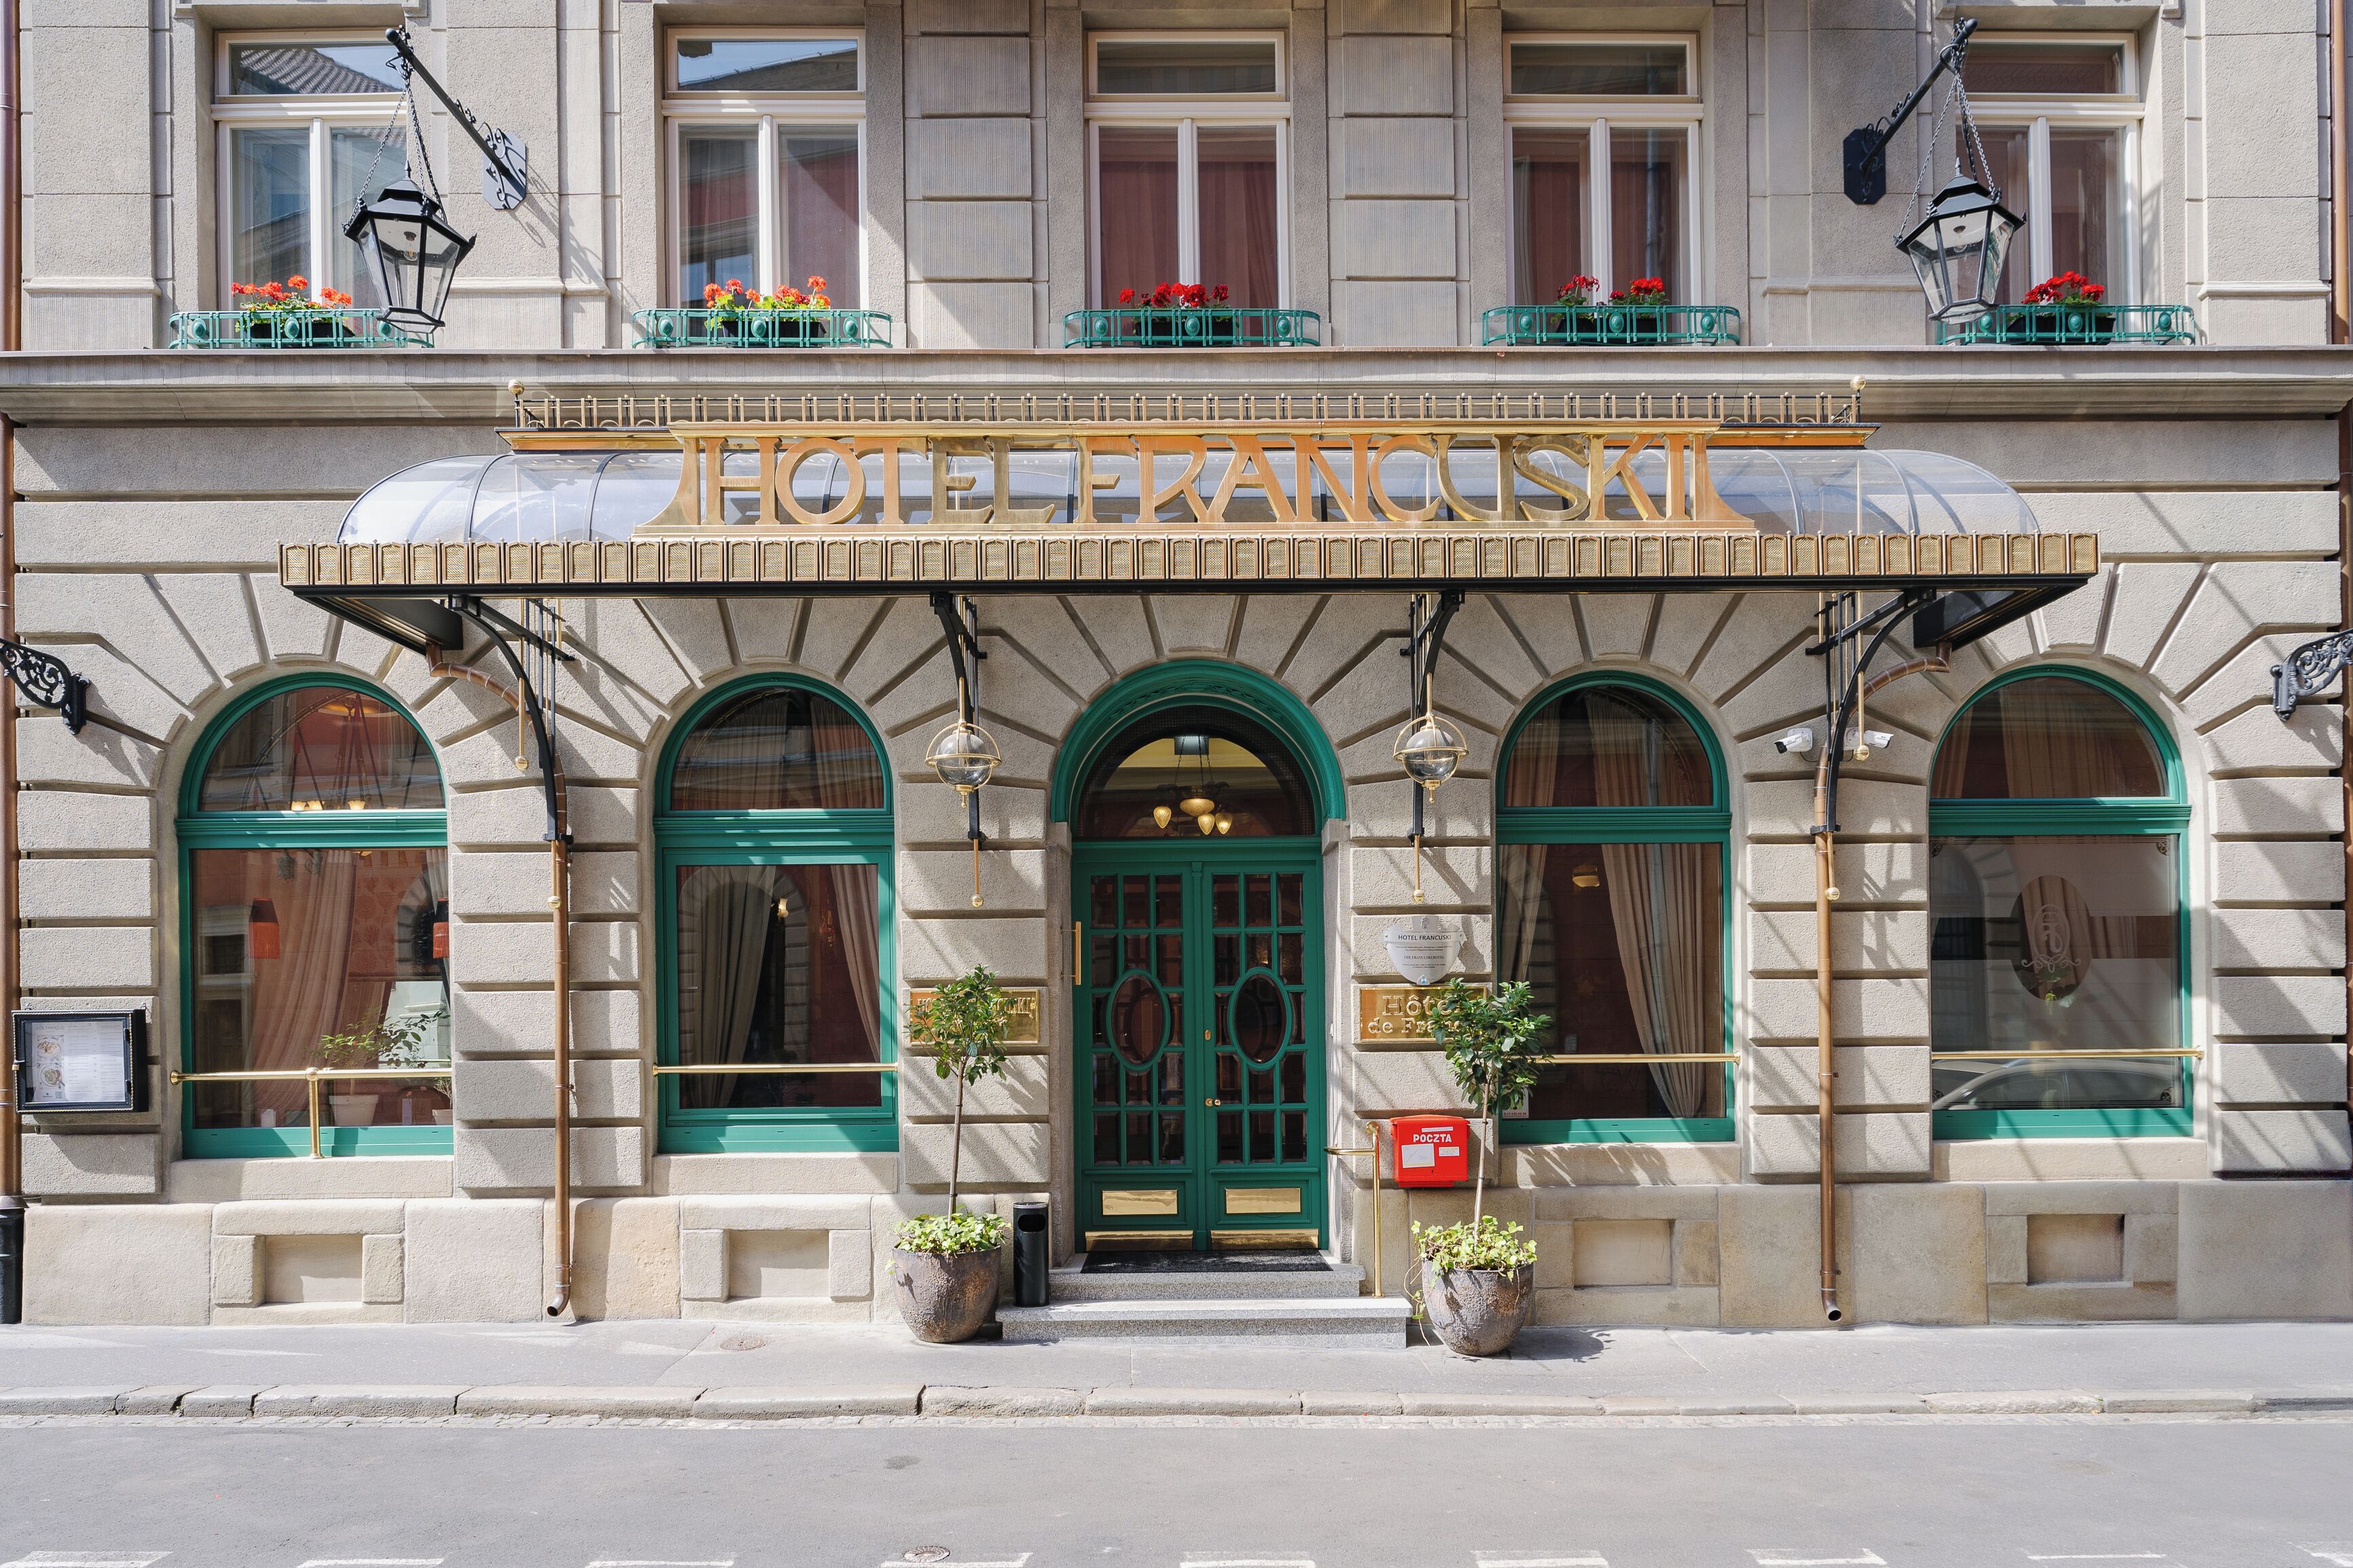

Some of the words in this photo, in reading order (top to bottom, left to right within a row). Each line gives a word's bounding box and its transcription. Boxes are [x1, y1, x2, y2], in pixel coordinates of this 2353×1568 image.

[701, 436, 1056, 526] HOTEL
[1072, 433, 1691, 524] FRANCUSKI
[1382, 994, 1460, 1016] Hôte
[1367, 1017, 1393, 1034] de
[1413, 1133, 1452, 1143] POCZTA
